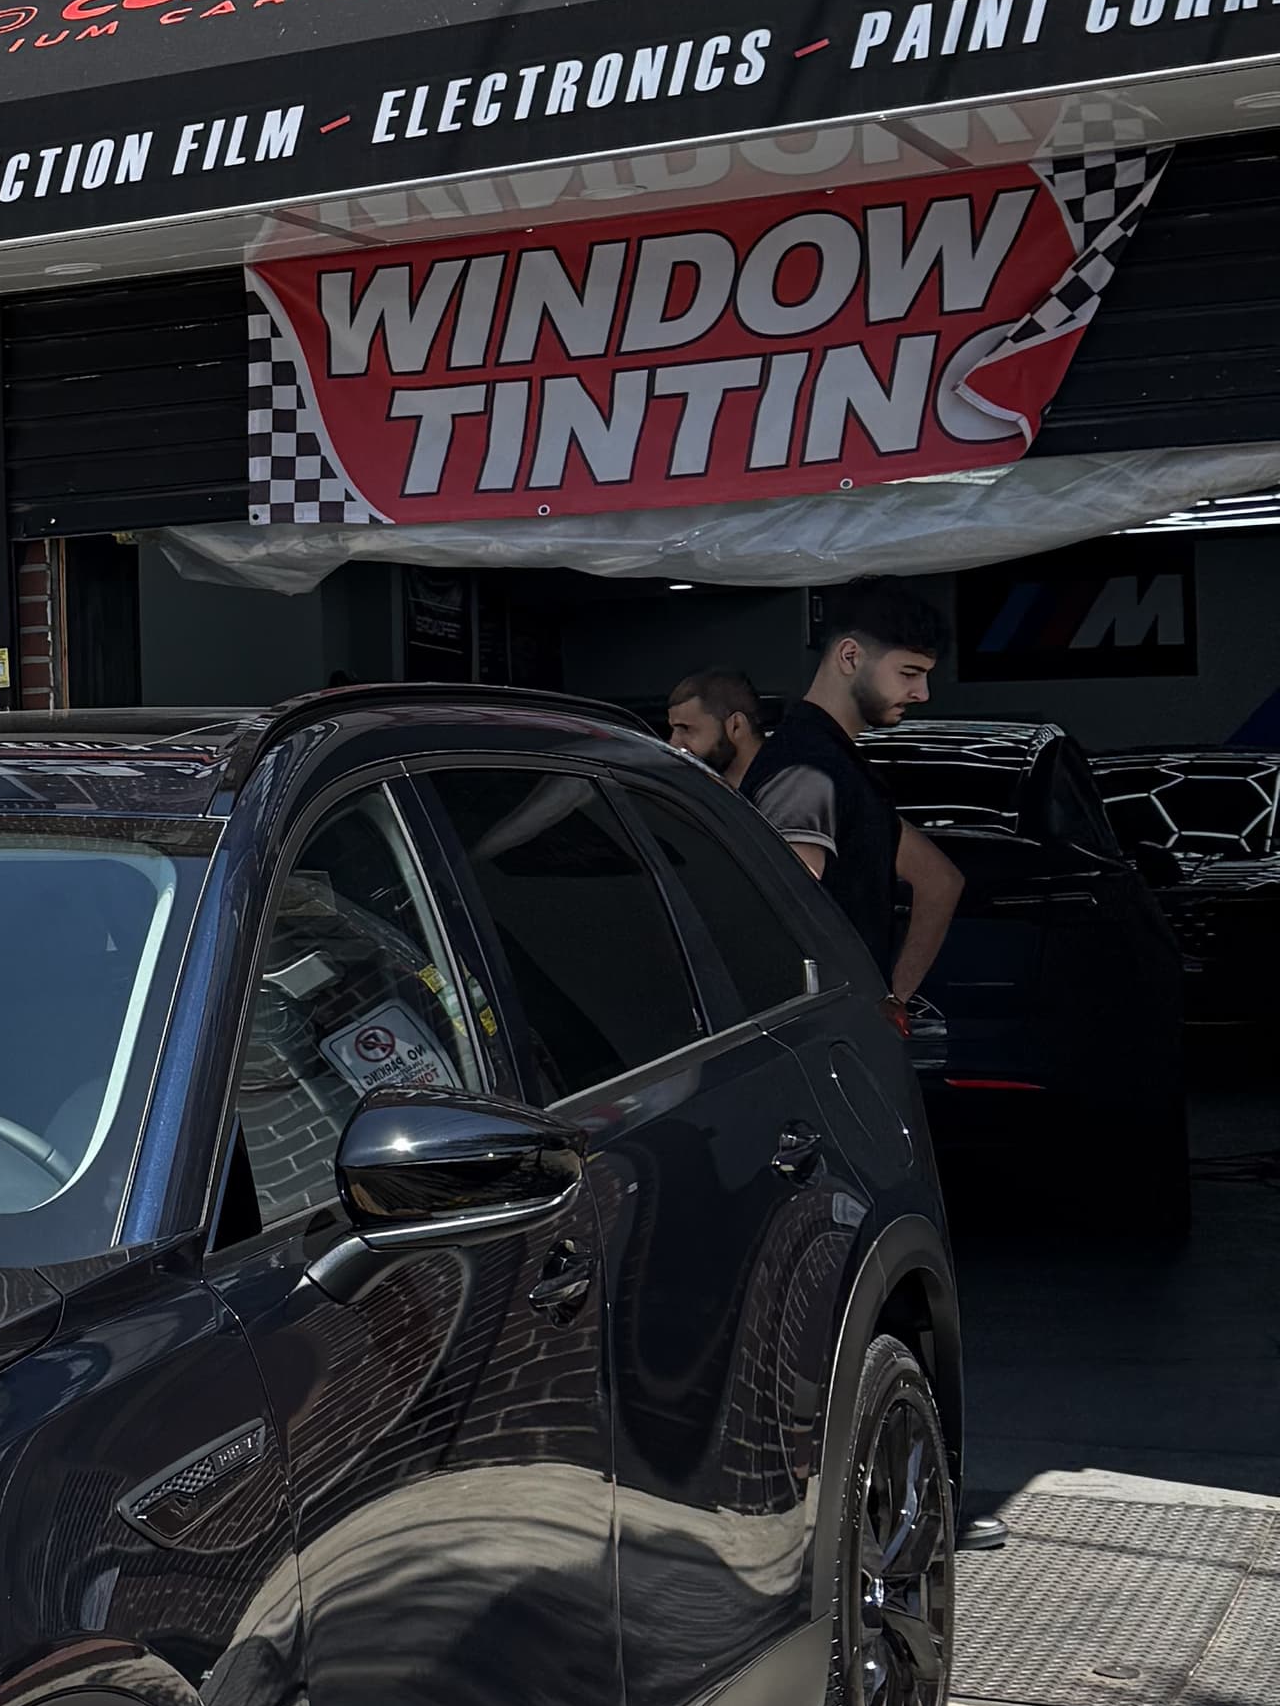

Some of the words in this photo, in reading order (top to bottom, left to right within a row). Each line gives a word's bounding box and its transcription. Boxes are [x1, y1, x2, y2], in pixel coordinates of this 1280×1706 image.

[171, 104, 306, 177] FILM
[371, 28, 773, 144] ELECTRONICS
[312, 183, 1041, 379] WINDOW
